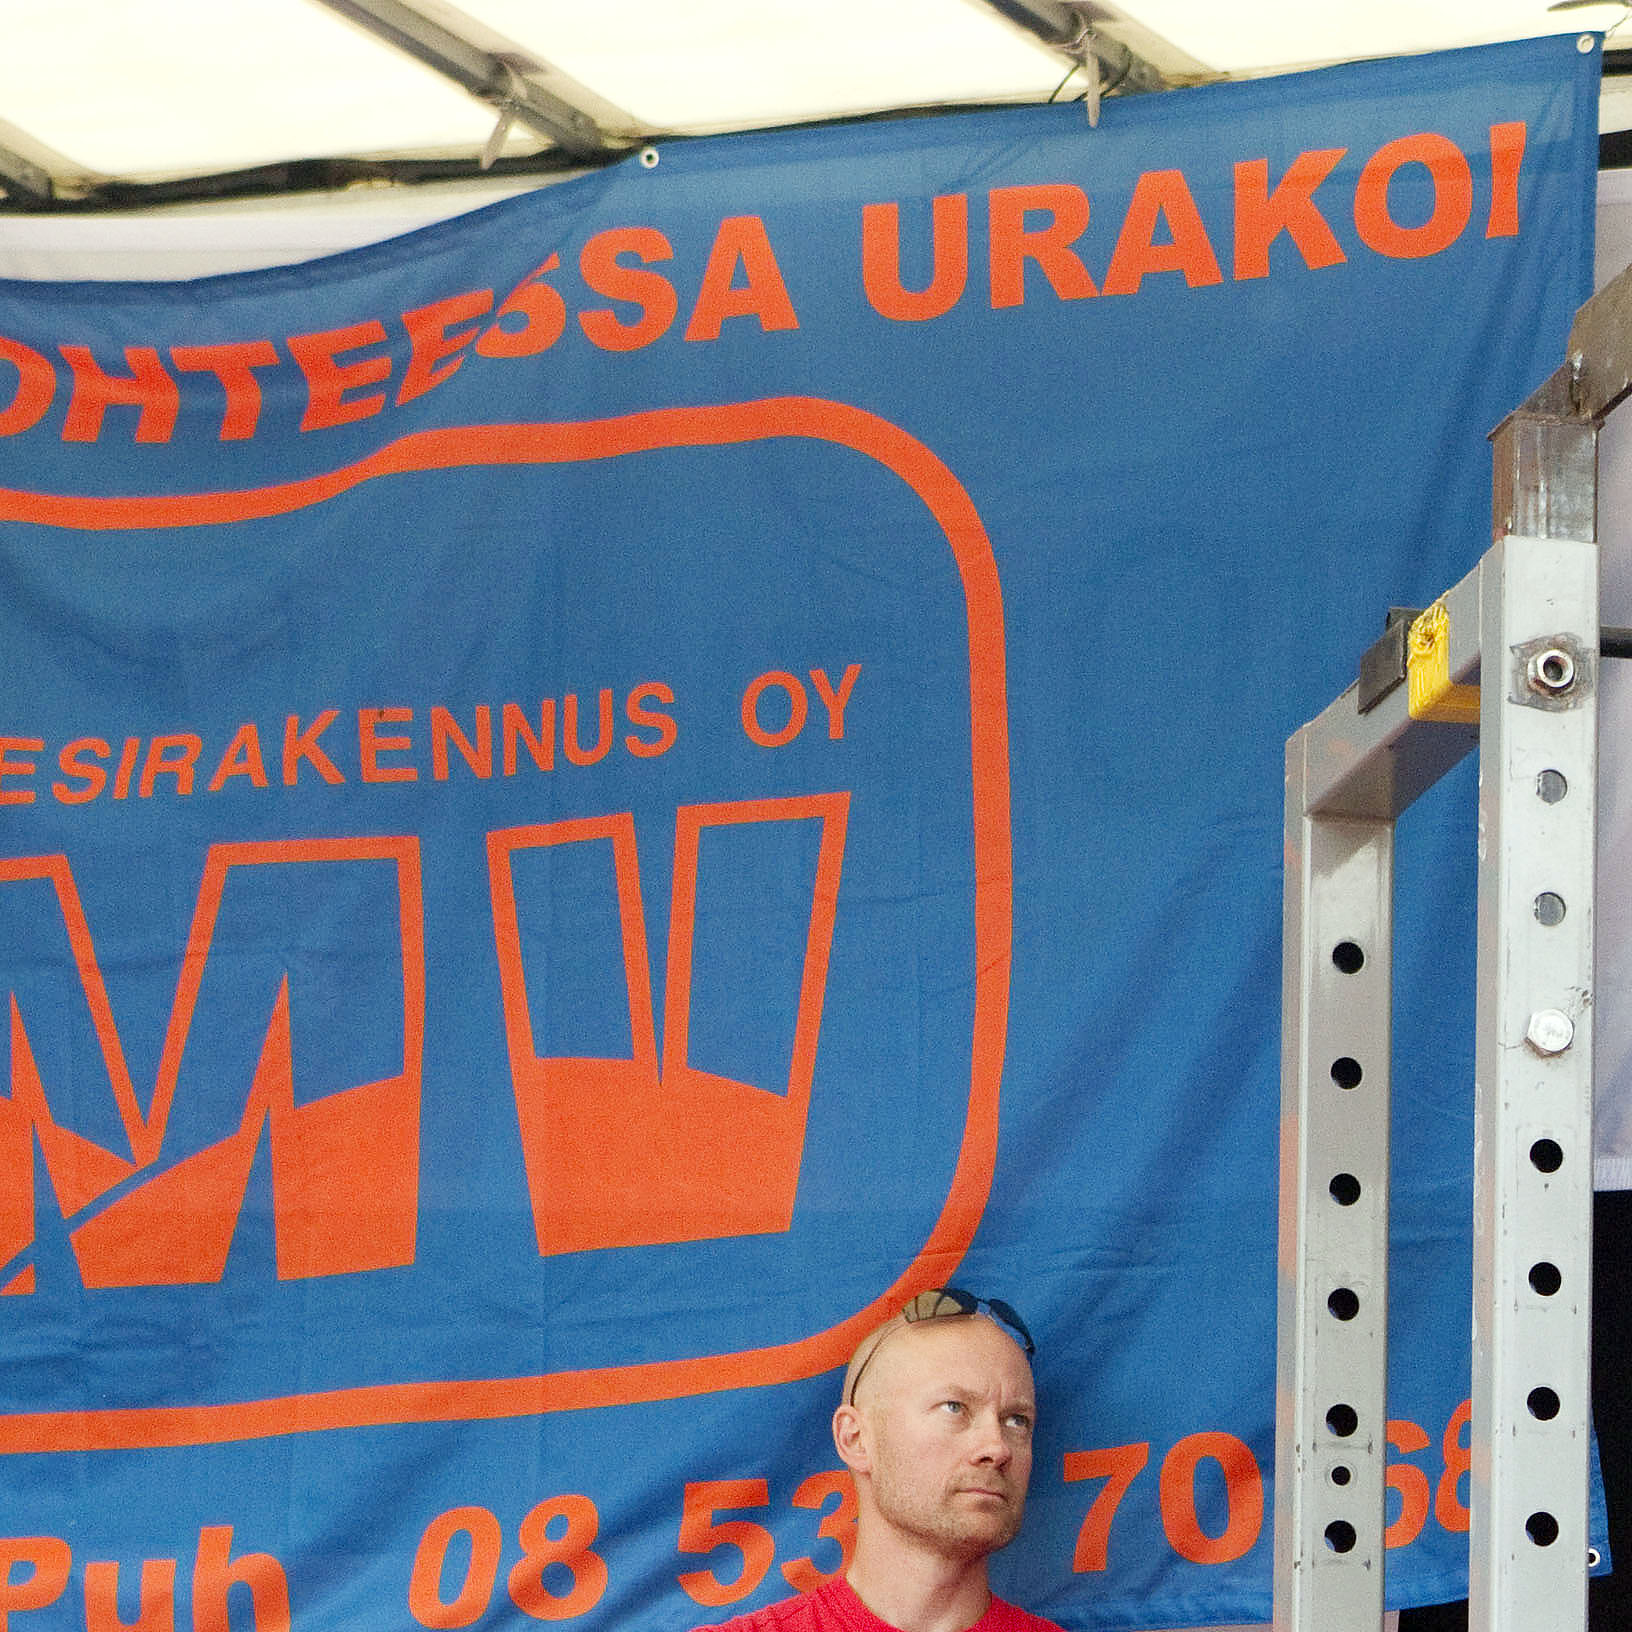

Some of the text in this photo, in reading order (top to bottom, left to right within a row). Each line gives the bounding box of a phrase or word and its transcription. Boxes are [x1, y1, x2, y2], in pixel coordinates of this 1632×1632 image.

[862, 122, 1527, 322] URAKOI
[742, 664, 862, 748] OY
[409, 1494, 609, 1631] 08
